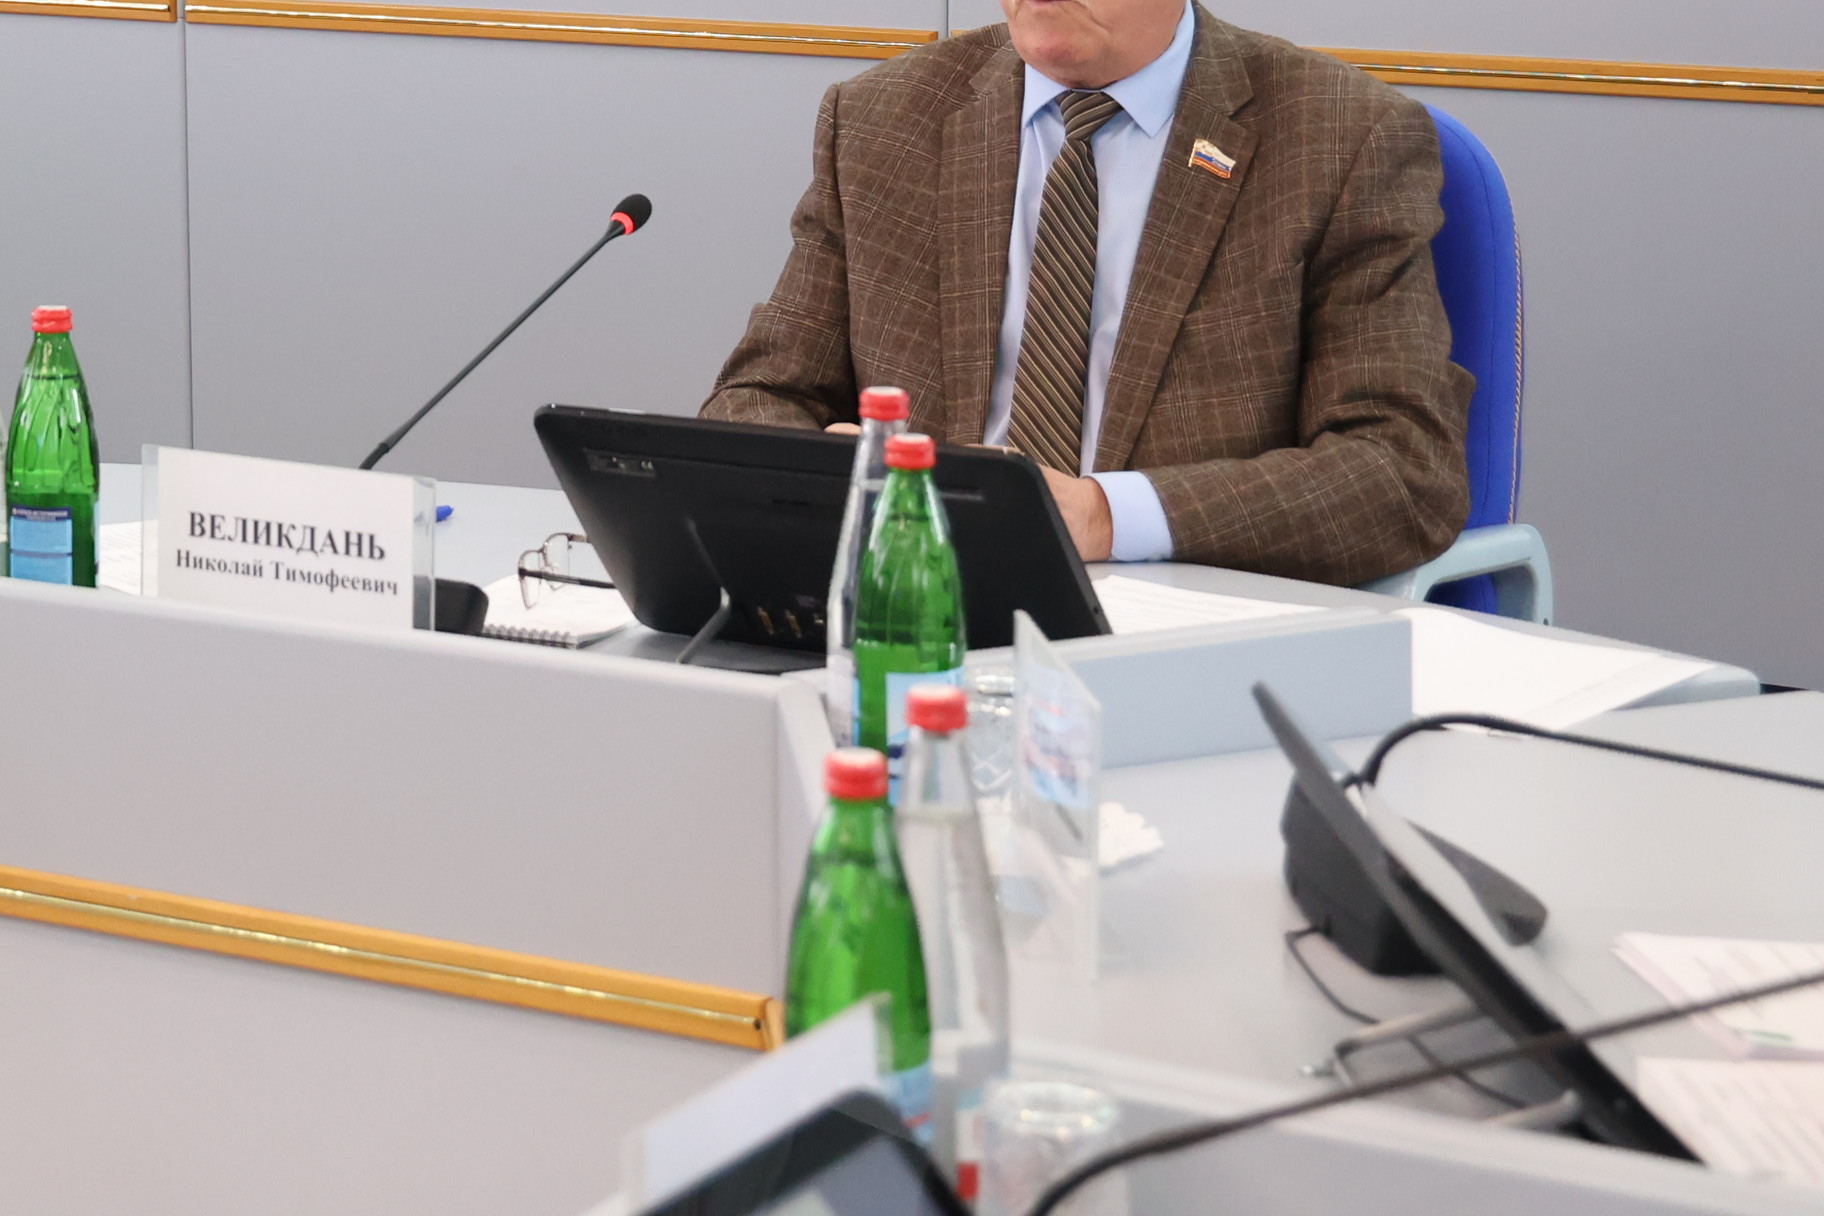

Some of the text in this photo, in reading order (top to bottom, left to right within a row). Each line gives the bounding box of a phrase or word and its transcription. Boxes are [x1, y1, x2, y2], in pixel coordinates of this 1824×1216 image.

[188, 511, 386, 561] ВЕЛИКДАНЬ
[176, 550, 398, 596] Николай Тимофеевич
